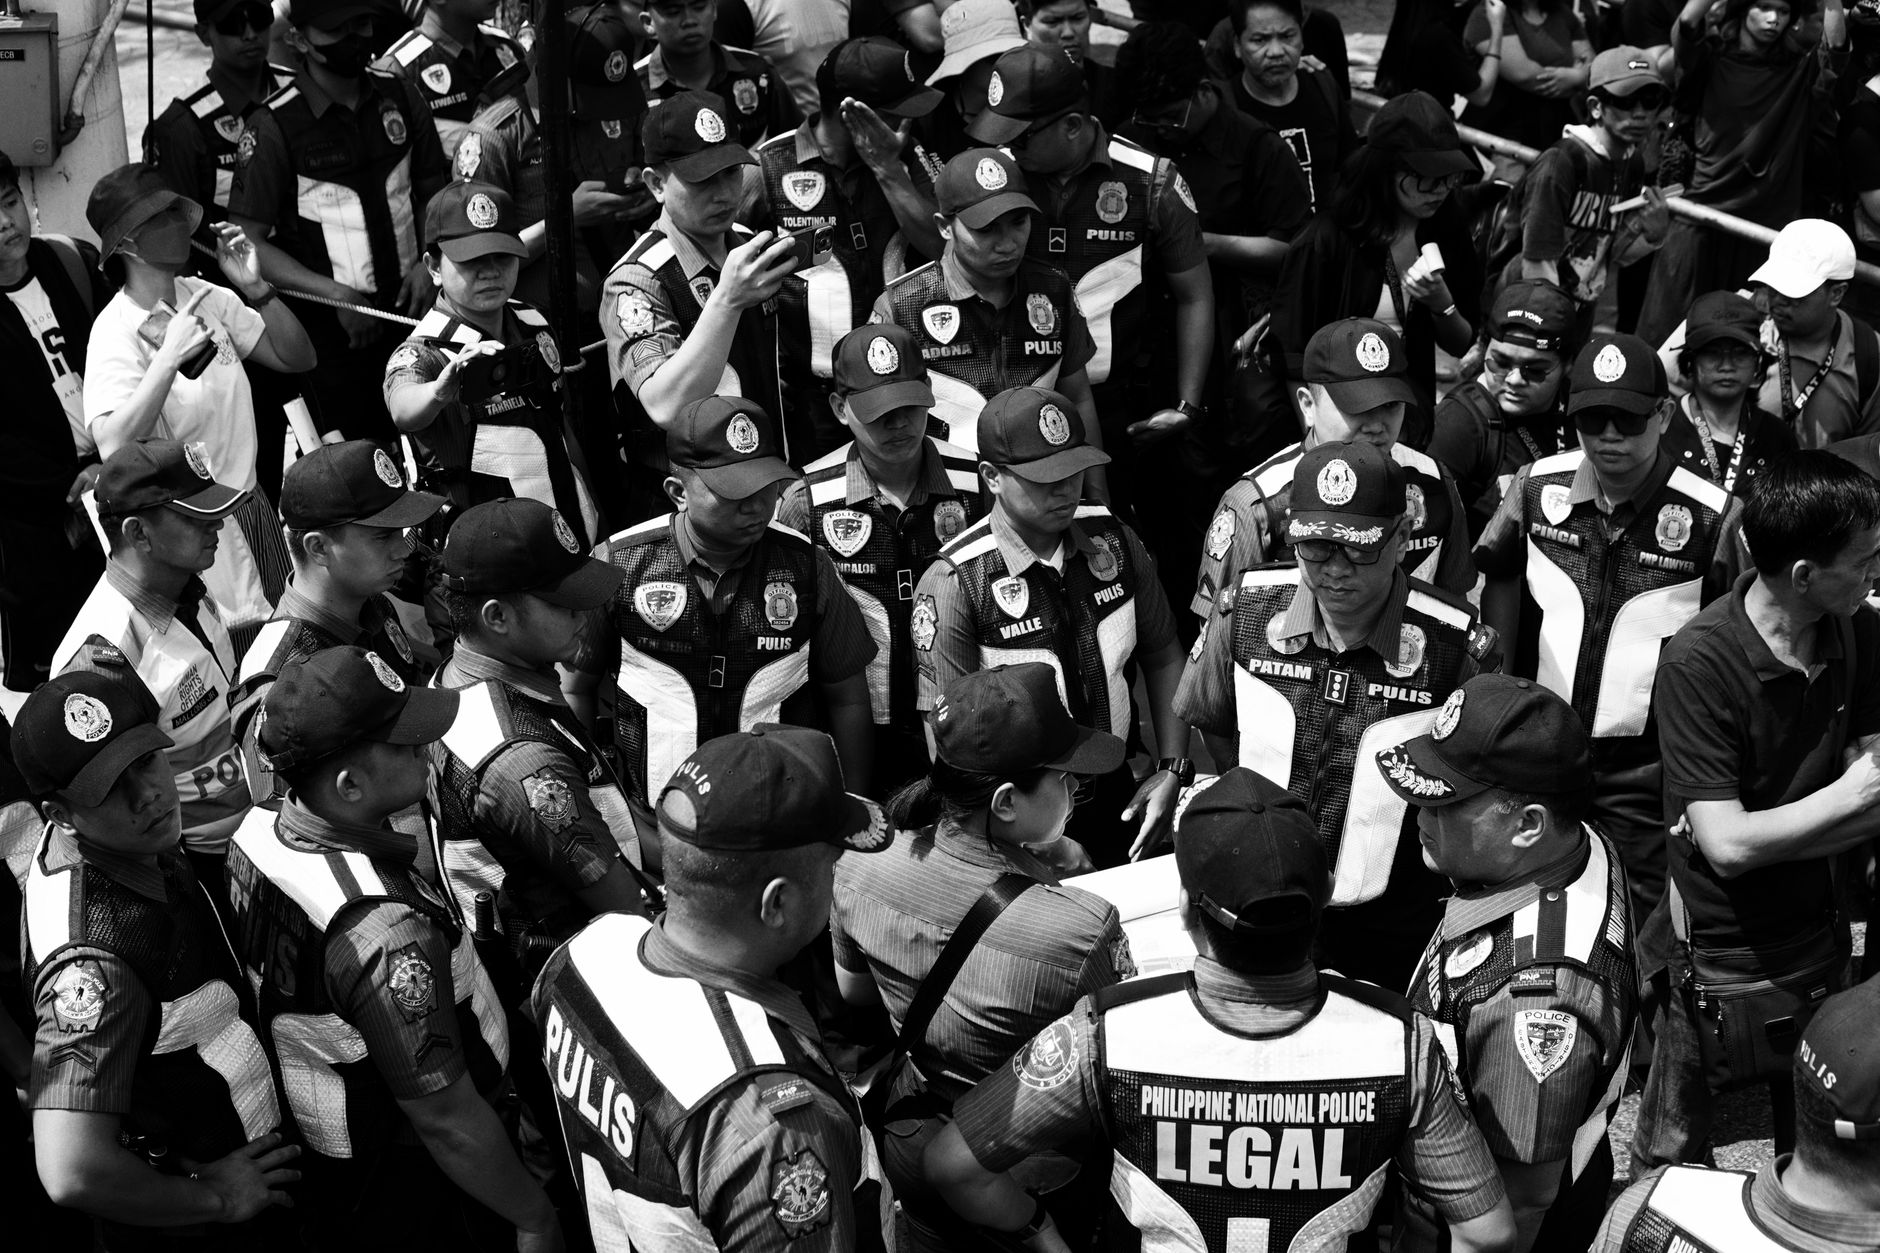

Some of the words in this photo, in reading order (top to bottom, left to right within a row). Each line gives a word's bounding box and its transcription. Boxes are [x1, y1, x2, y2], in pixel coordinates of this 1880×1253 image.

[783, 216, 826, 228] TOLENTINO
[828, 216, 838, 226] JR
[1086, 229, 1136, 241] PULIS
[1507, 310, 1523, 318] NEW
[1524, 311, 1544, 325] YORK
[1024, 341, 1063, 355] PULIS
[1723, 466, 1737, 492] AT
[1730, 431, 1746, 466] LUX
[1406, 536, 1438, 552] ULIS
[1530, 522, 1579, 547] PINCA
[836, 562, 876, 574] NDALOR
[1639, 551, 1658, 565] PNP
[1659, 555, 1695, 573] LAWYER
[642, 583, 680, 592] POLICE
[1094, 583, 1124, 605] PULIS
[1000, 617, 1042, 639] VALLE
[757, 636, 792, 650] PULIS
[1249, 658, 1312, 680] PATAM
[179, 674, 203, 701] RIGHTS
[181, 684, 207, 712] OFFICER
[1368, 683, 1433, 705] PULIS
[1427, 952, 1442, 1012] PULIS
[1519, 973, 1540, 981] PNP
[1524, 1011, 1571, 1023] POLICE
[1800, 1040, 1837, 1089] PULIS
[545, 1005, 637, 1159] PULIS
[777, 1086, 798, 1099] PNP
[1141, 1084, 1231, 1122] PHILIPPINE
[1235, 1092, 1315, 1125] NATIONAL
[1318, 1091, 1376, 1123] POLICE
[1156, 1122, 1352, 1190] LEGAL
